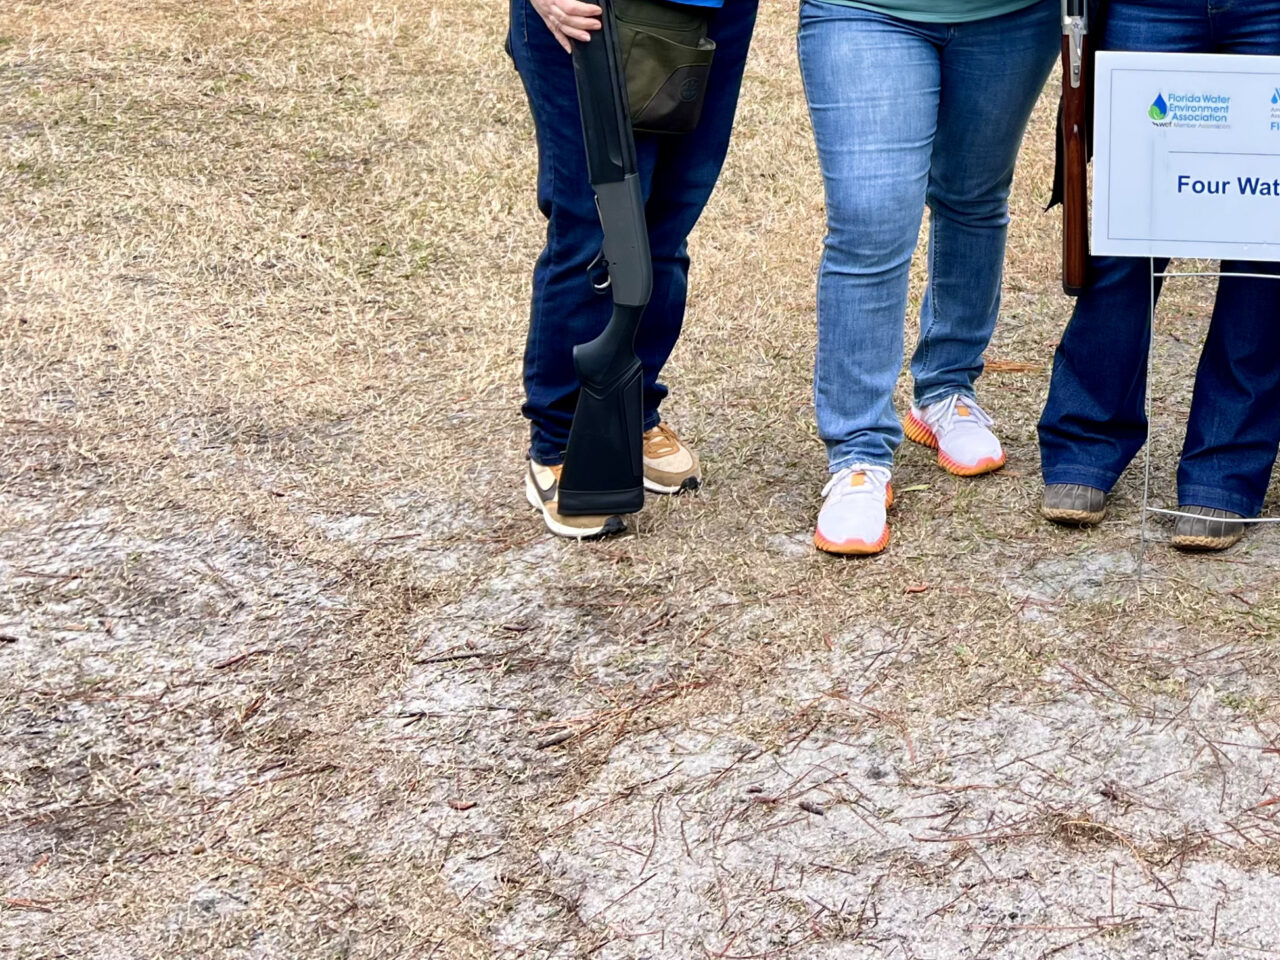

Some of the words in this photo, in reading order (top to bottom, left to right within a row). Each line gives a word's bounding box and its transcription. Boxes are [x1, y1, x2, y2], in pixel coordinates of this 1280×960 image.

[1168, 93, 1201, 103] Florida
[1202, 94, 1231, 105] Water
[1168, 103, 1229, 114] Environment
[1171, 112, 1227, 123] Association
[1177, 175, 1231, 194] Four
